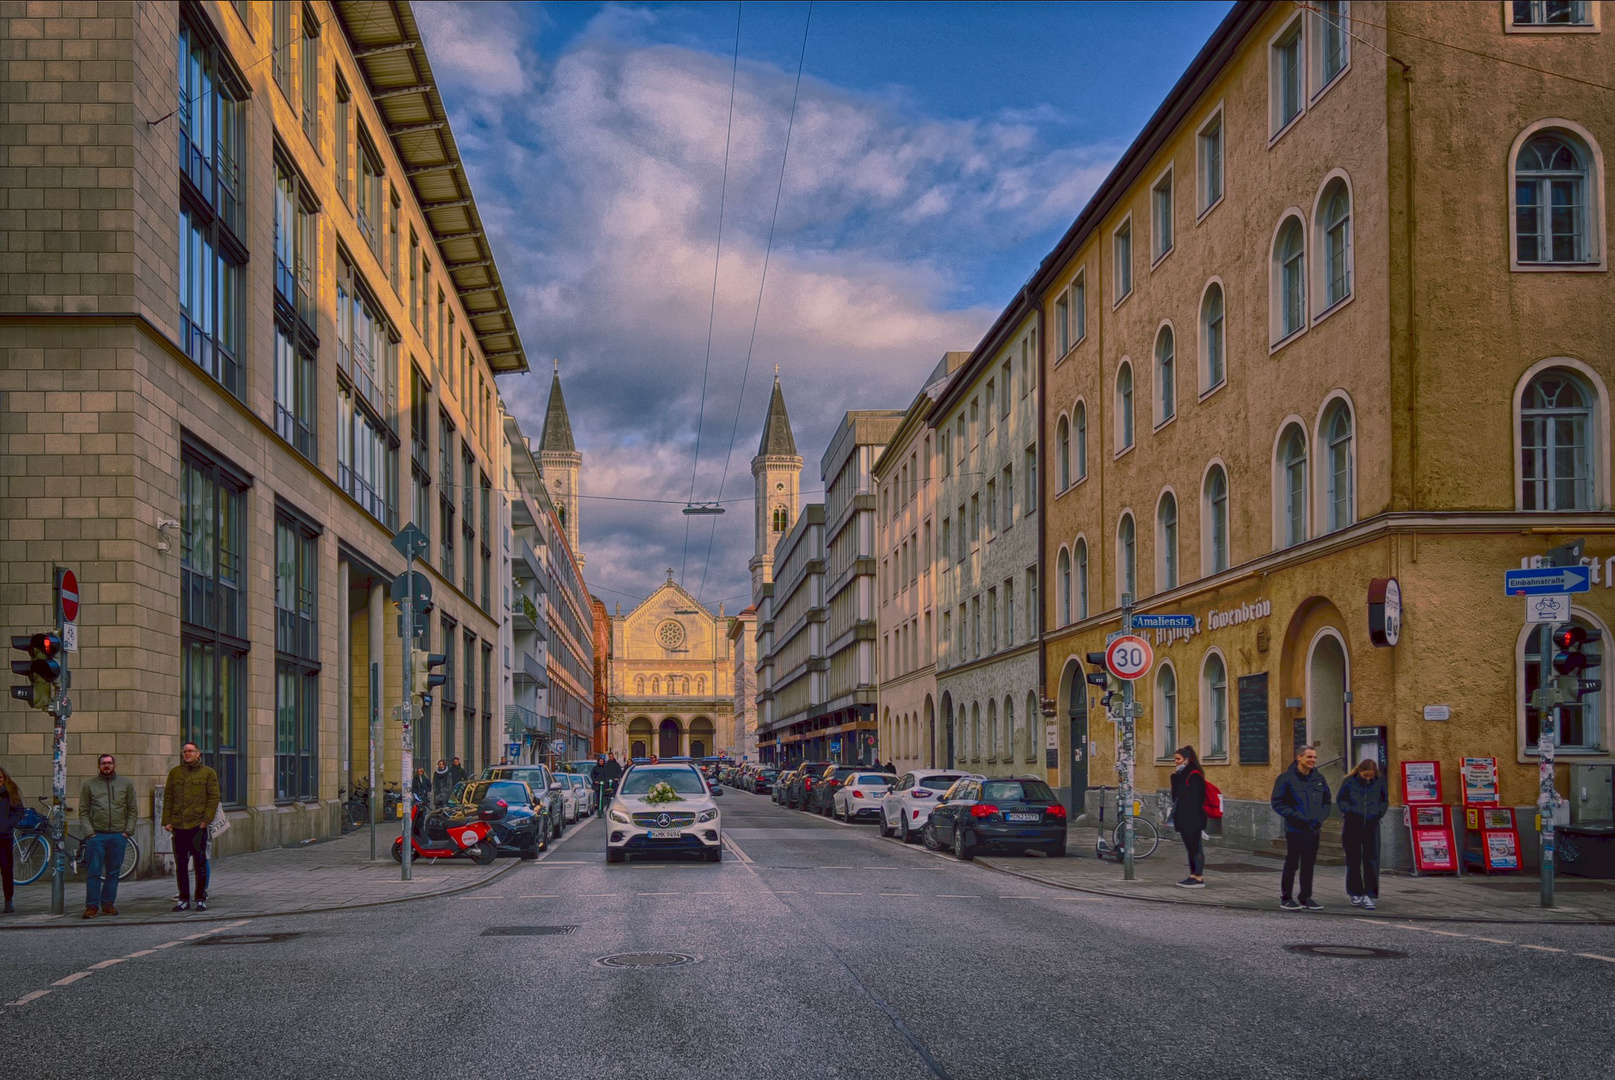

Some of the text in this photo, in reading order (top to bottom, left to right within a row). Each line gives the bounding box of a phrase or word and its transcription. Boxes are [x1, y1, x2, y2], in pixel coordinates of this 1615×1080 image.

[1509, 577, 1565, 587] Einbahnstraße
[1134, 616, 1190, 627] Amalienstr.
[1208, 597, 1271, 631] Löwenbräu
[1116, 648, 1142, 667] 30
